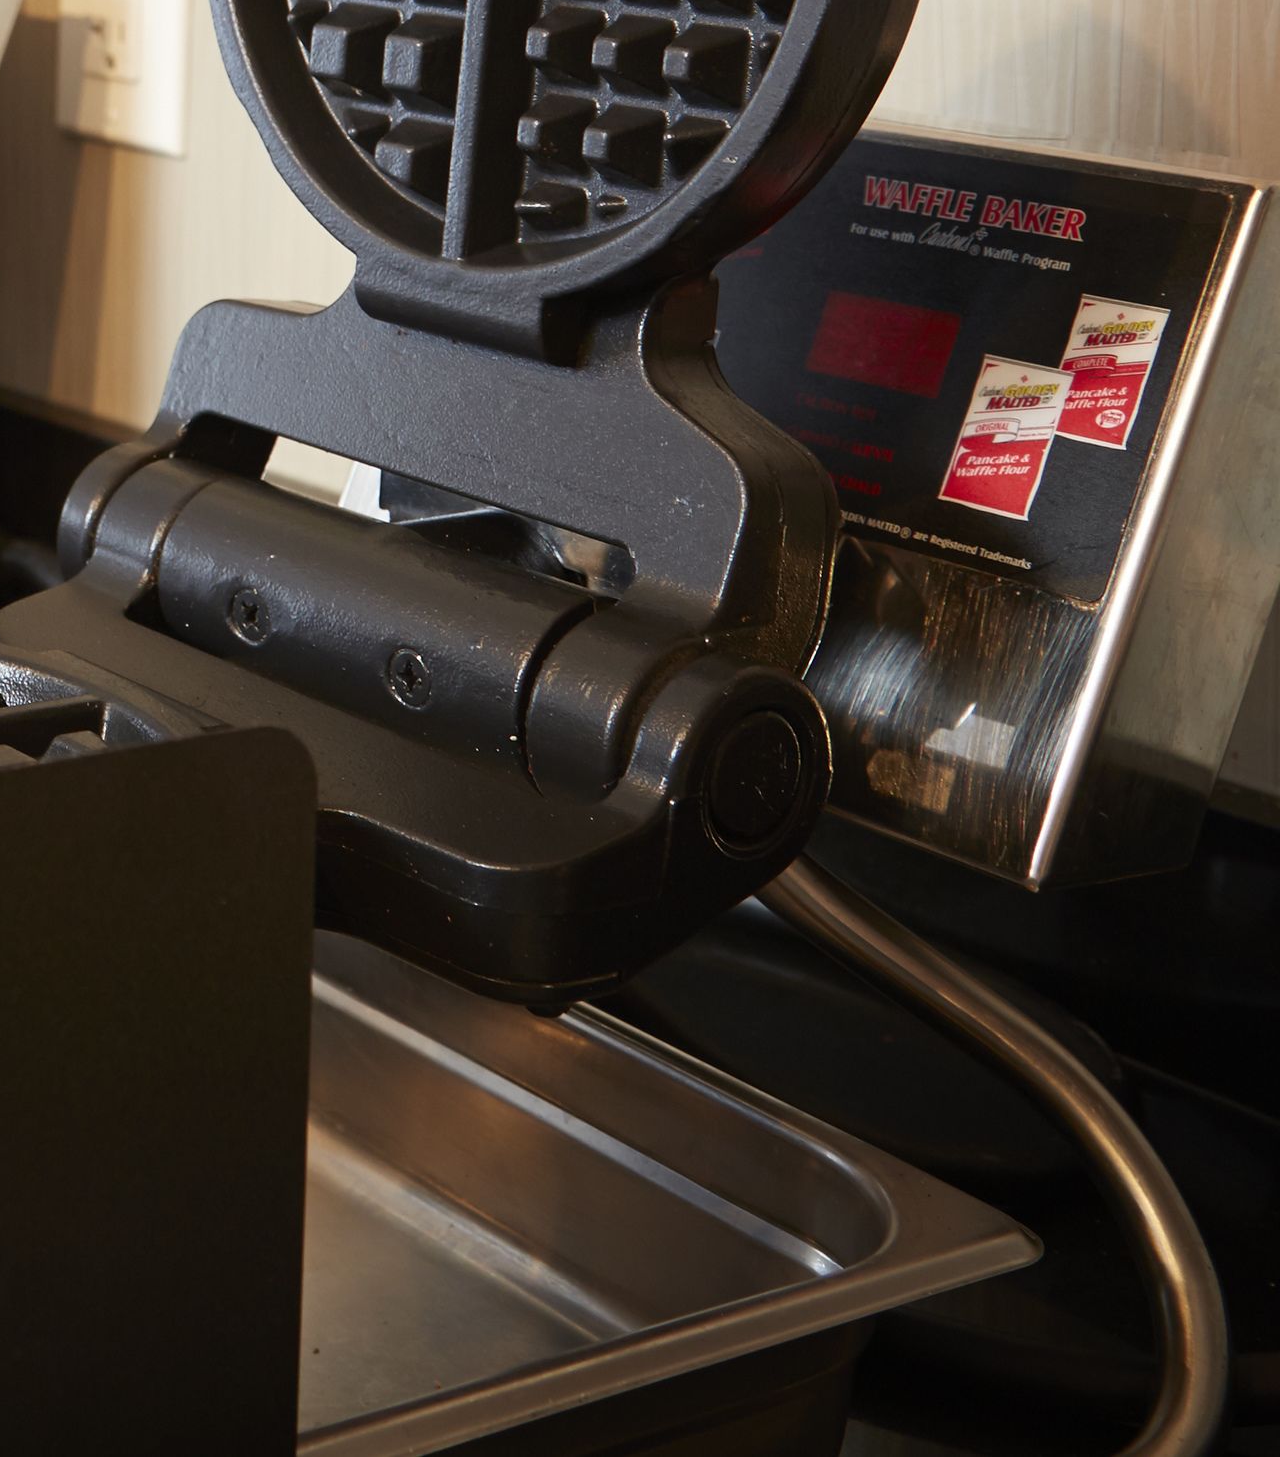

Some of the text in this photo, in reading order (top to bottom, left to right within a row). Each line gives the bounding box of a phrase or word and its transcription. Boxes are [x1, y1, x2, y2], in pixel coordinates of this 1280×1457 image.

[864, 175, 1087, 242] WAFFLE BAKER
[850, 223, 867, 235] For
[870, 229, 889, 240] use
[892, 231, 915, 244] with
[983, 246, 1019, 263] Waffle
[1021, 253, 1072, 272] Program
[1084, 332, 1137, 346] MALTED
[1068, 387, 1128, 399] Pancake &
[986, 396, 1040, 410] MALTED
[1065, 398, 1129, 409] affle Flour
[975, 422, 1009, 433] ORIGINAL
[966, 453, 1031, 465] Pancake &
[956, 465, 1031, 477] Waffle Flour
[913, 532, 929, 542] are
[930, 534, 979, 556] Registered
[979, 547, 1032, 570] Trademarks
